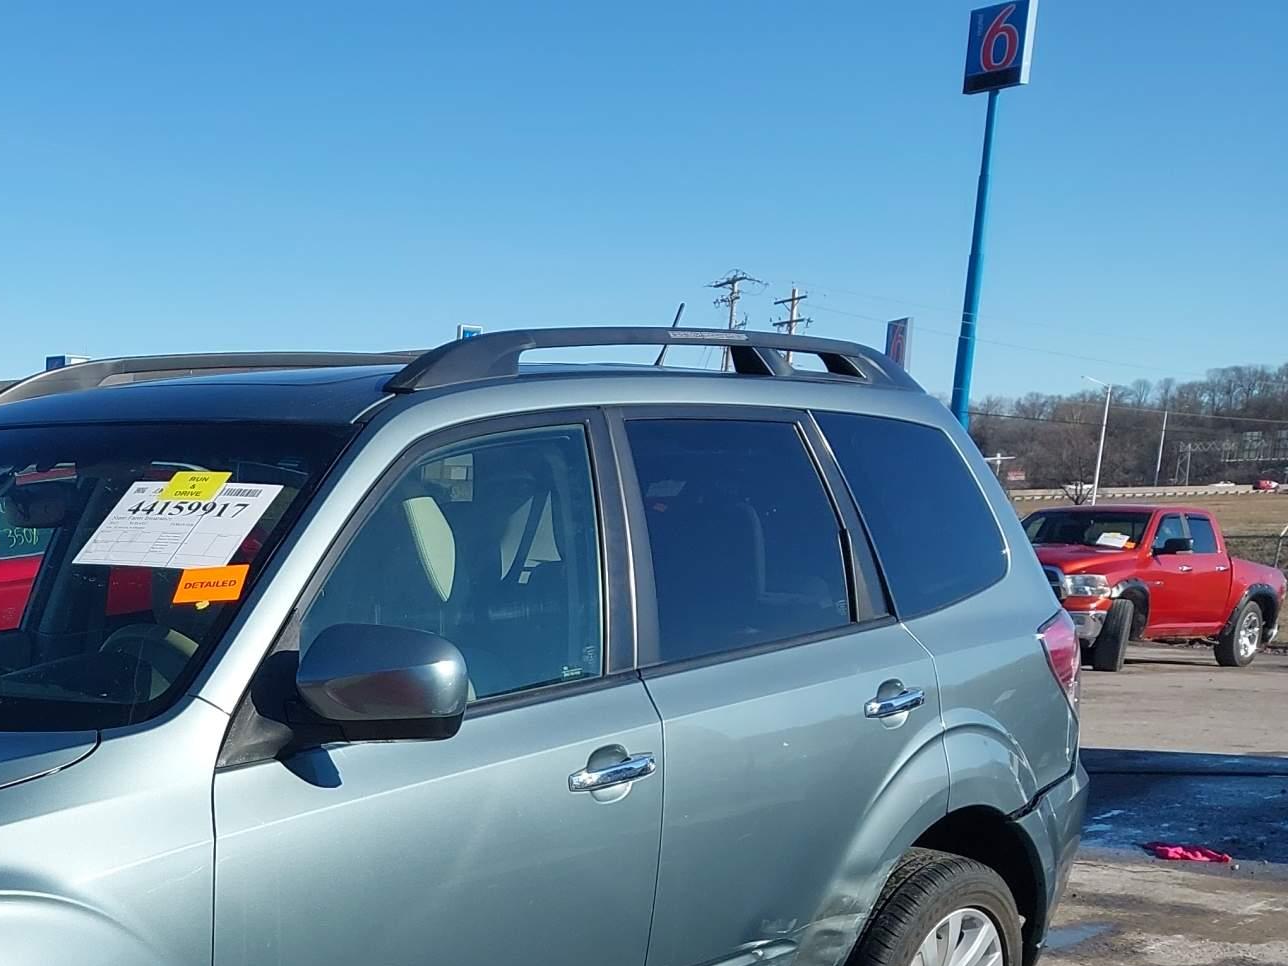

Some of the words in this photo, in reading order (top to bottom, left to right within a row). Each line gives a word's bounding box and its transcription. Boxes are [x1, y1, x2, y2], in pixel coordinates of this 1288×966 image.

[980, 4, 1019, 72] 6
[128, 500, 249, 518] 44159917
[184, 580, 237, 589] DETAILED
